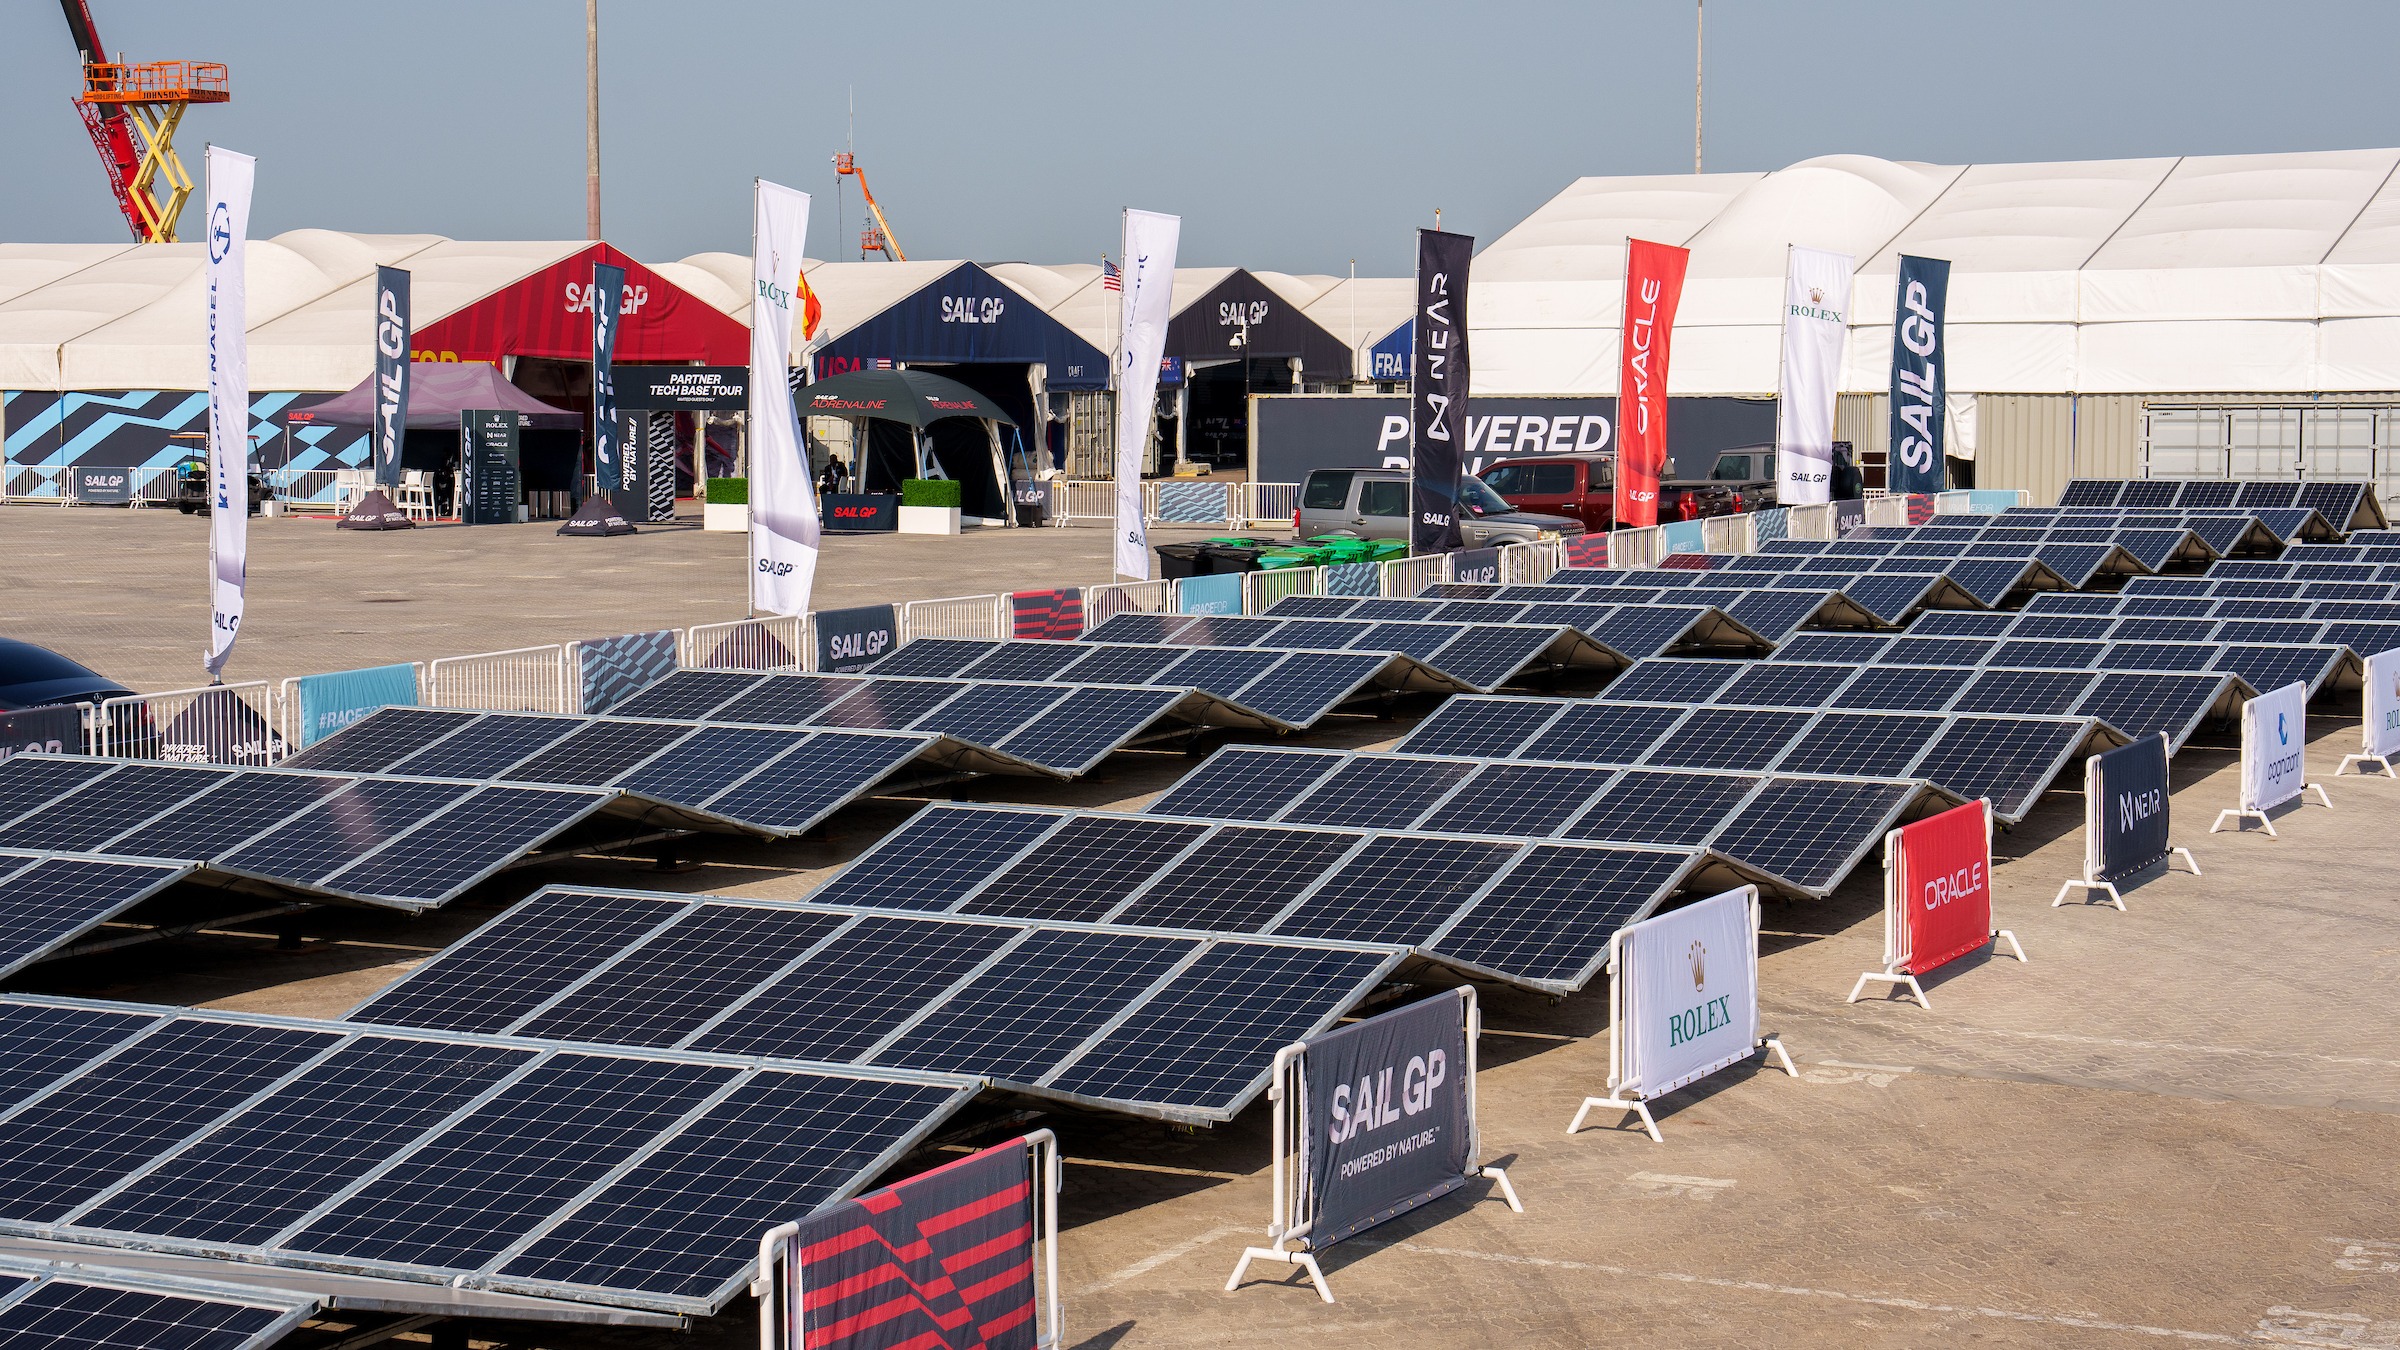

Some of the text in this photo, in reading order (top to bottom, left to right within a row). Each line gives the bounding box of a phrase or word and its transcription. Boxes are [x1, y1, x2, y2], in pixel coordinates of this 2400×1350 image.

[142, 91, 180, 100] JOHNSON
[620, 286, 648, 315] GP
[941, 296, 1005, 324] SAIL GP
[1250, 300, 1268, 325] GP
[378, 288, 404, 360] GP
[1790, 304, 1842, 322] ROLEX
[1426, 272, 1450, 380] NEAR
[1375, 353, 1403, 376] FRA
[669, 374, 722, 384] PARTNER
[1900, 280, 1936, 474] SAIL GP
[650, 385, 743, 396] TECH BASE TOUR
[288, 412, 304, 420] SAIL
[809, 400, 887, 409] ADRENALINE
[464, 426, 472, 507] SAIL GP
[622, 442, 630, 491] POWERED
[630, 466, 637, 482] BY
[1790, 472, 1827, 482] SAIL GP
[84, 475, 124, 486] SAIL GP
[1638, 492, 1654, 502] GP
[834, 507, 877, 518] SAIL GP
[1423, 512, 1445, 526] SAIL
[1840, 514, 1853, 530] SAIL
[776, 562, 794, 577] GP
[830, 630, 889, 660] SAIL GP
[2268, 750, 2300, 784] cognizant
[2135, 788, 2161, 821] NEAR
[1925, 862, 1982, 910] ORACLE
[1669, 994, 1731, 1048] ROLEX
[1329, 1048, 1447, 1145] SAIL GP
[1340, 1144, 1385, 1180] POWERED
[1385, 1140, 1398, 1162] BY
